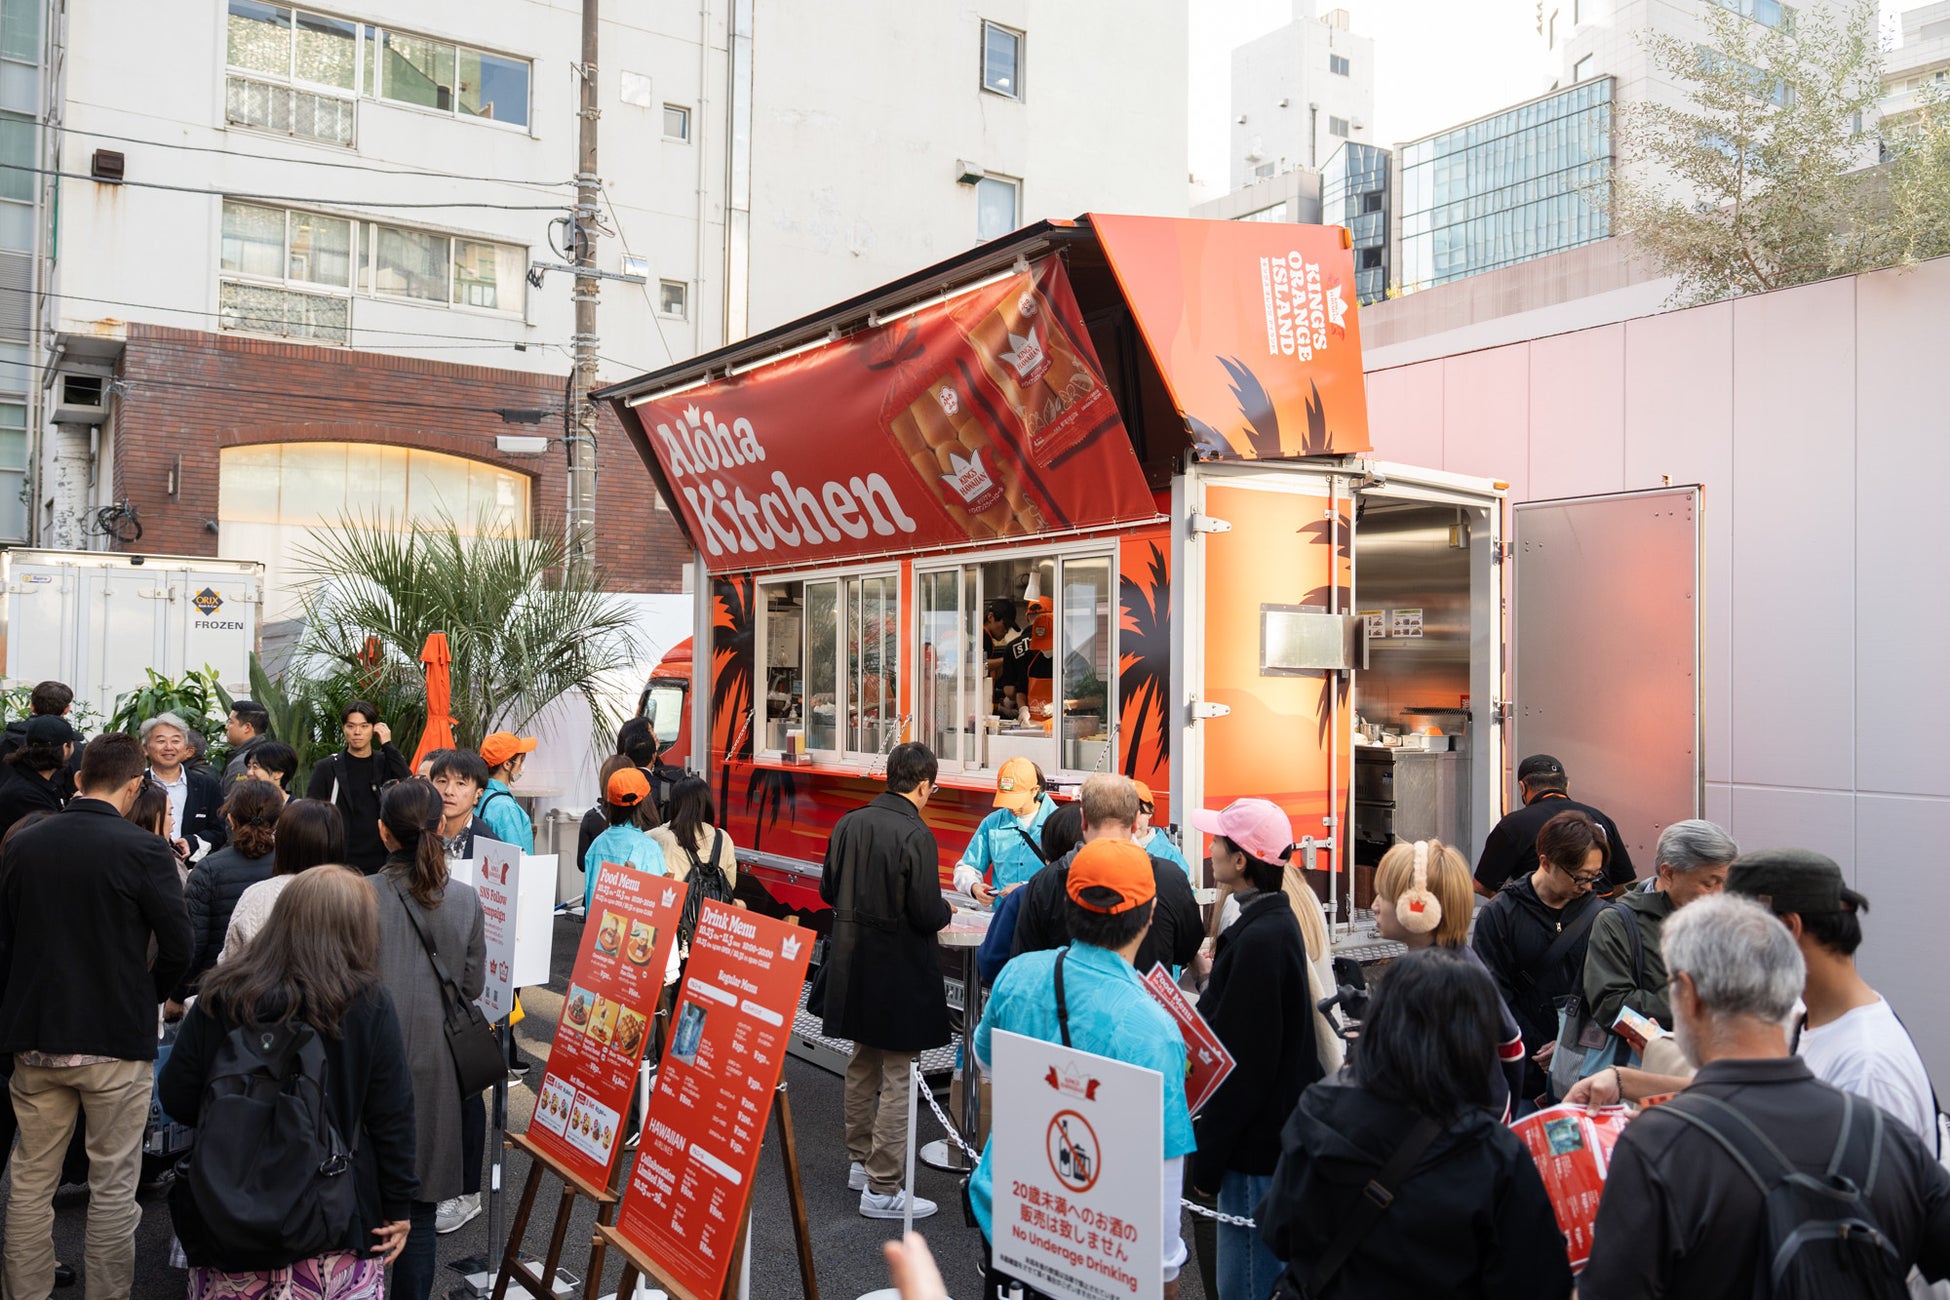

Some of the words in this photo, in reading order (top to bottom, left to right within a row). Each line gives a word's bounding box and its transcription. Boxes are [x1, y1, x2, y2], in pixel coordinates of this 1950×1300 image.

[1272, 257, 1294, 355] ISLAND
[1288, 251, 1312, 361] ORANGE
[1305, 263, 1327, 350] KING'S
[1017, 347, 1041, 369] HAWAIIAN
[657, 410, 766, 477] Aloha
[959, 472, 988, 496] HAWAIIAN
[683, 471, 917, 556] Kitchen
[195, 596, 219, 605] ORIX
[195, 621, 244, 630] FROZEN
[480, 885, 490, 899] SNS
[490, 889, 508, 905] Follow
[600, 868, 619, 886] Food
[619, 873, 640, 892] Menu
[701, 906, 729, 930] Drink
[728, 915, 757, 939] Menu
[717, 969, 741, 987] Regular
[740, 979, 758, 995] Menu
[1155, 971, 1174, 994] Food
[1171, 991, 1194, 1022] Menu
[648, 1117, 686, 1152] HAWAIIAN
[654, 1139, 673, 1157] AIRLINES
[637, 1163, 657, 1185] Limited
[656, 1177, 672, 1196] Menu
[640, 1152, 676, 1184] Collaboration
[1012, 1180, 1138, 1243] 20歳未満へのお酒の
[1020, 1203, 1128, 1262] 販売は致しません
[1012, 1225, 1027, 1241] No
[1029, 1231, 1084, 1267] Underage
[1086, 1256, 1138, 1293] Drinking
